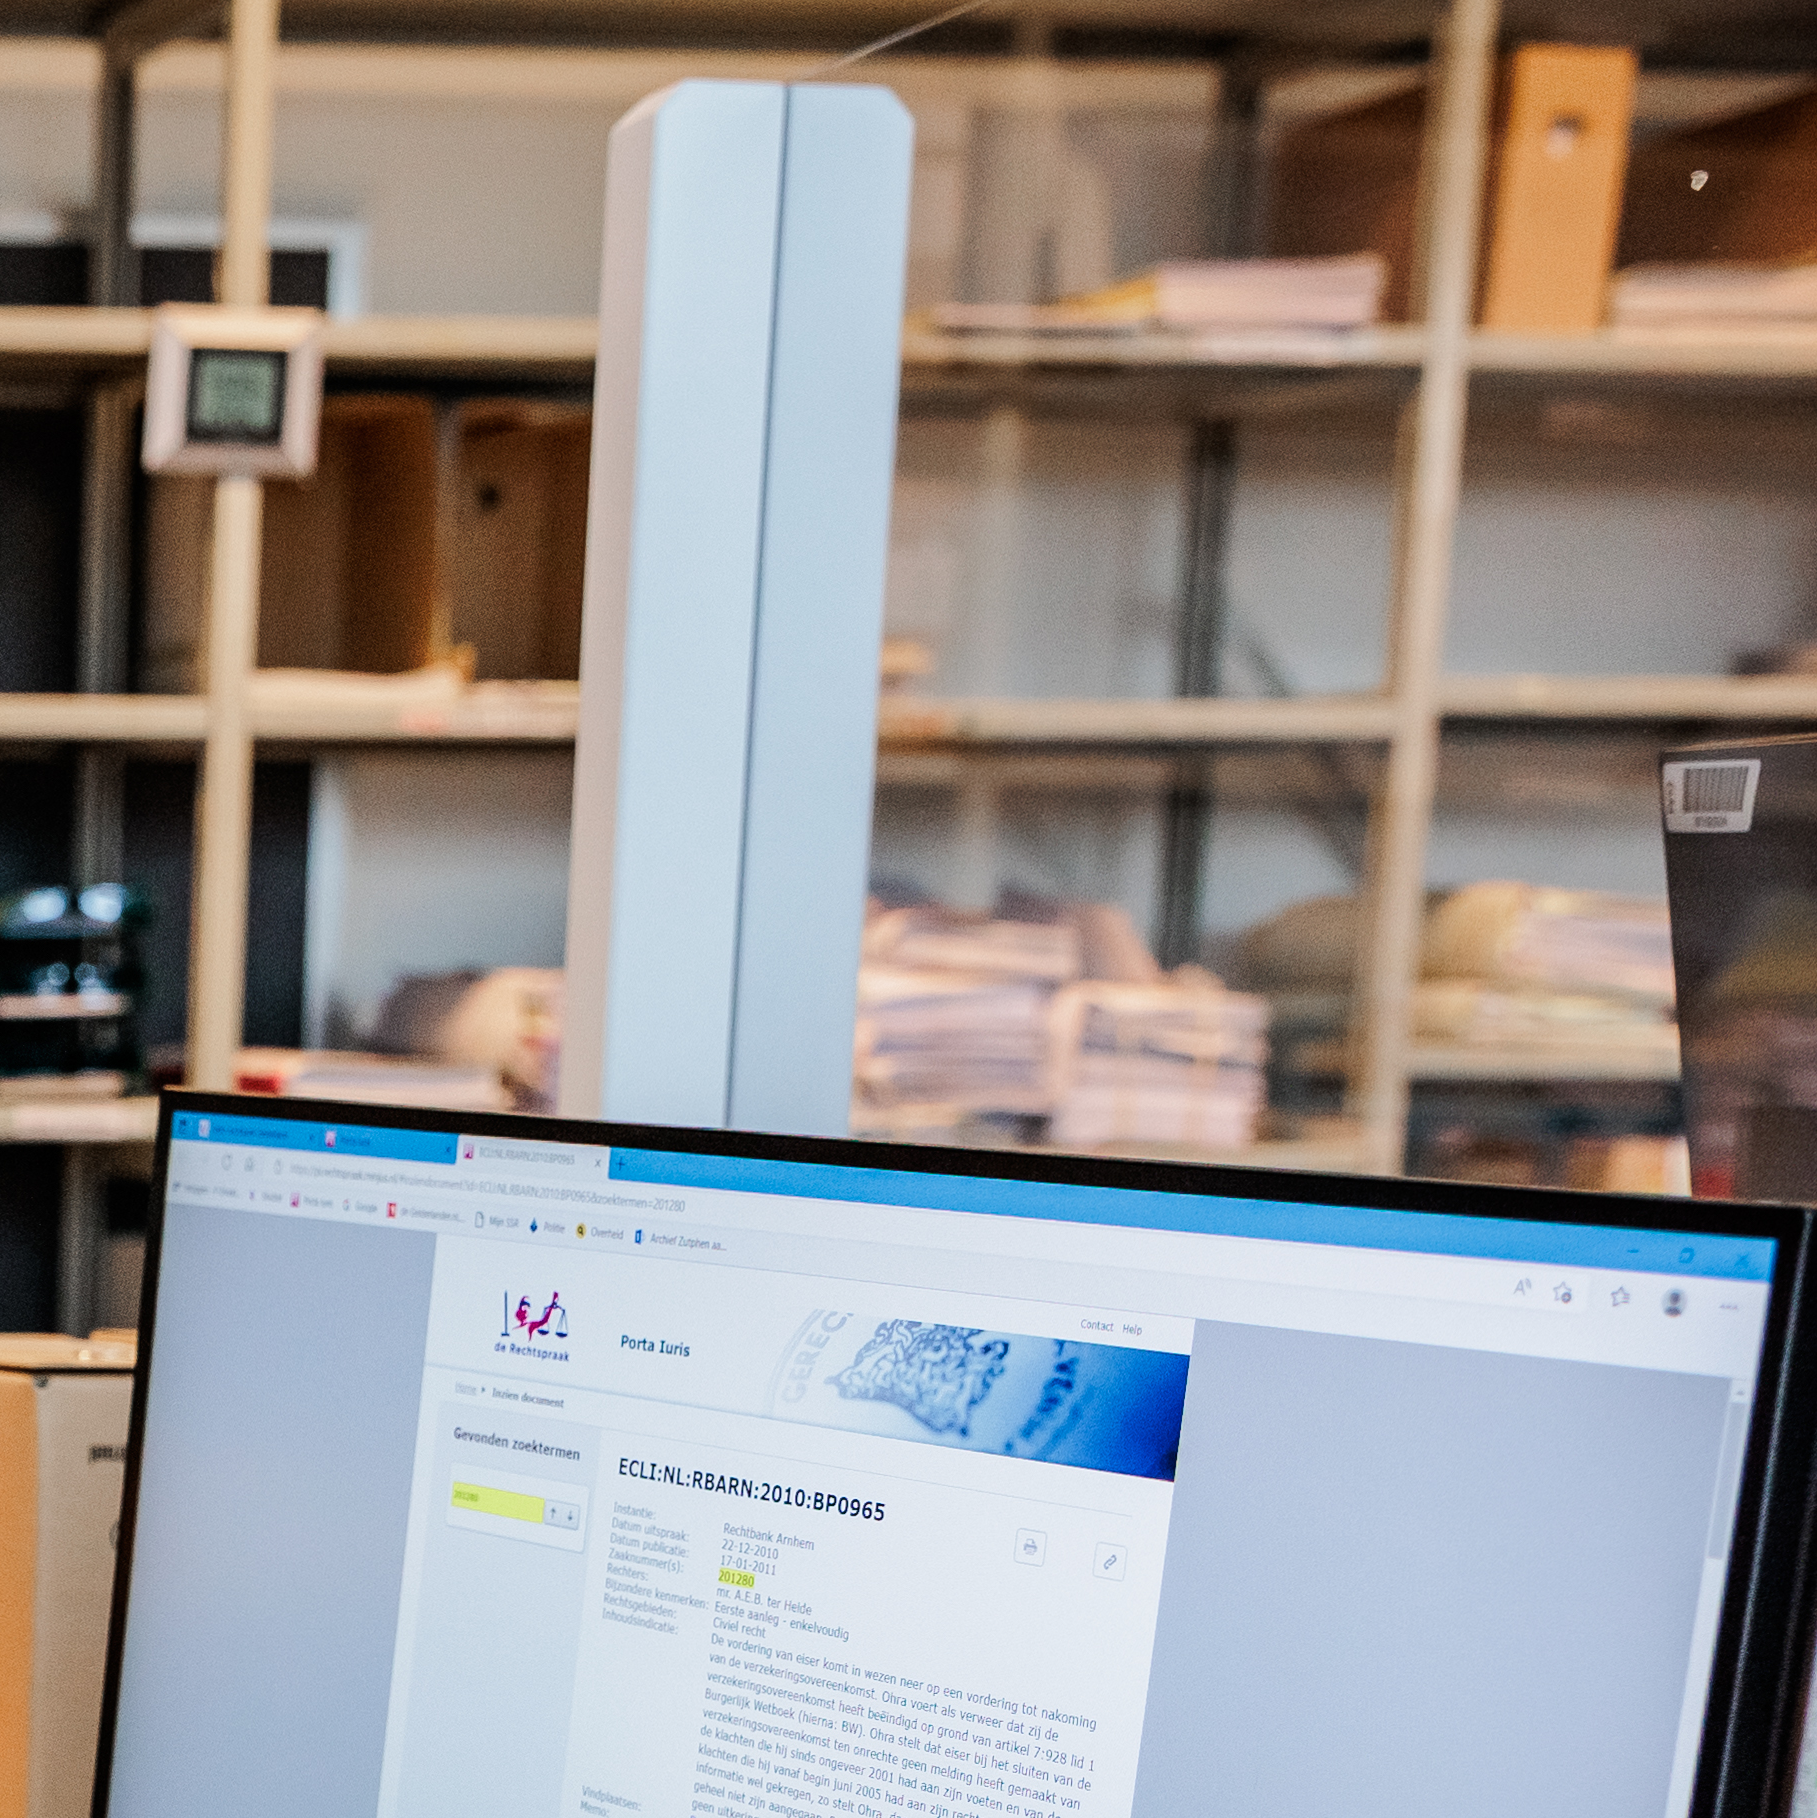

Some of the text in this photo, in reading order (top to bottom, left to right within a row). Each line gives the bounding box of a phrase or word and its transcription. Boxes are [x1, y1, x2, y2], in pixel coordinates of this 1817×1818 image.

[620, 1334, 690, 1357] Porta Iuris
[601, 1606, 679, 1635] Inhoudsindicatie:
[706, 1672, 835, 1711] verzekeringsovereenkomst
[838, 1699, 865, 1717] heeft
[920, 1722, 935, 1735] op
[937, 1726, 969, 1742] grond
[971, 1734, 991, 1747] van
[994, 1739, 1030, 1756] artikel
[1033, 1745, 1067, 1765] 7:928
[1070, 1753, 1085, 1769] lid
[709, 1653, 1059, 1742] van de verzekeringsovereenkomst. Ohra voert als verweer dat zij de
[710, 1632, 1097, 1732] De vordering van eiser komt in wezen neer op een vordering tot nakoming
